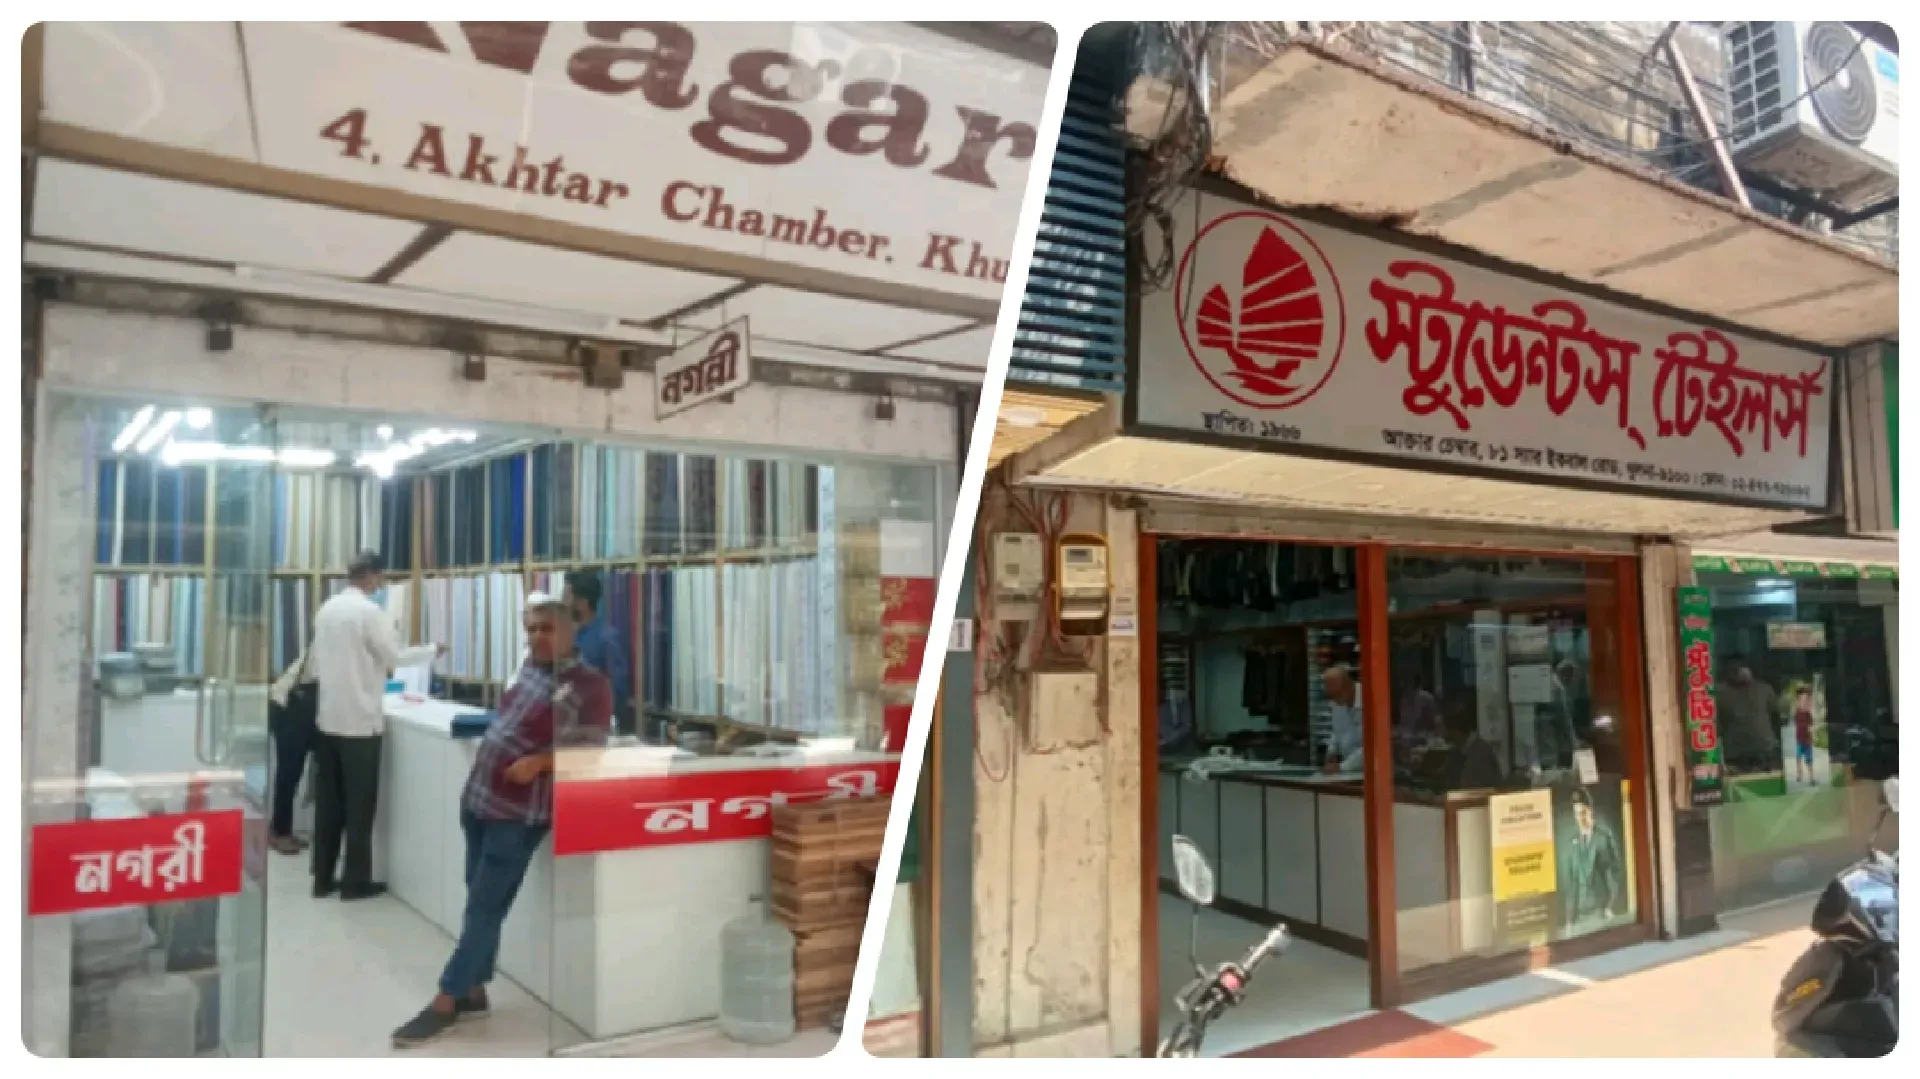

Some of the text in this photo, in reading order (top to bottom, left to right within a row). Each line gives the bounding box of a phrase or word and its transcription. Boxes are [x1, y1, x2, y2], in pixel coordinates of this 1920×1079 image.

[402, 120, 631, 210] Akhtar
[661, 331, 741, 405] নগরী
[1652, 327, 1828, 459] টেইলর্স
[69, 819, 207, 894] নগরী
